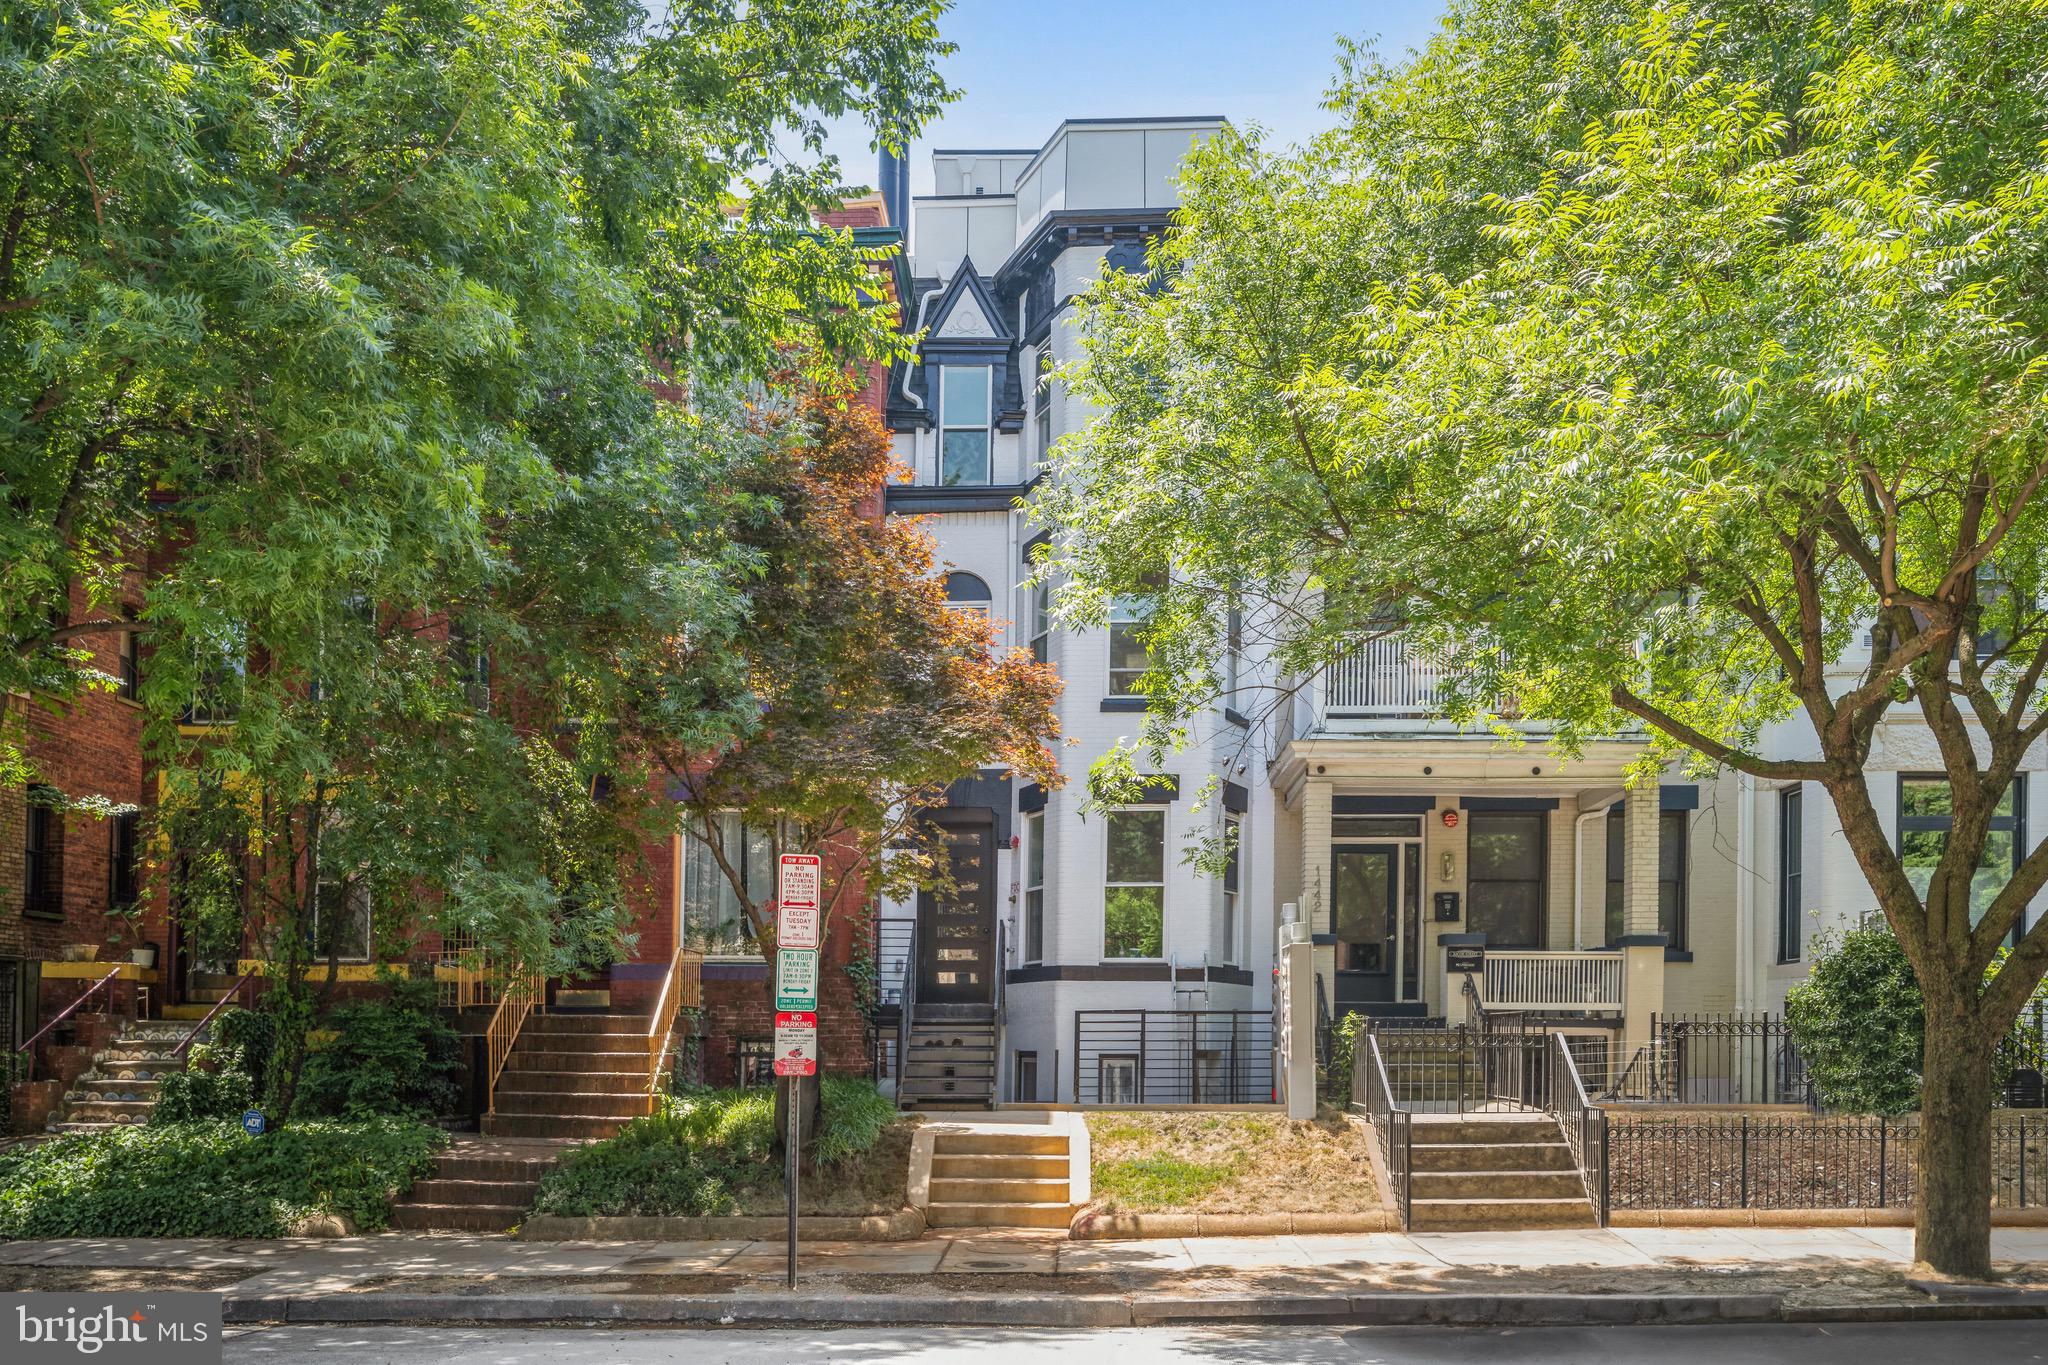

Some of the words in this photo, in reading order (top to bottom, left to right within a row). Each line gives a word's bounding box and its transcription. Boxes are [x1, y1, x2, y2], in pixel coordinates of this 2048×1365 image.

[1313, 865, 1321, 913] 1442
[783, 952, 795, 960] TWO
[796, 953, 813, 961] HOUR
[246, 1118, 261, 1128] ADT
